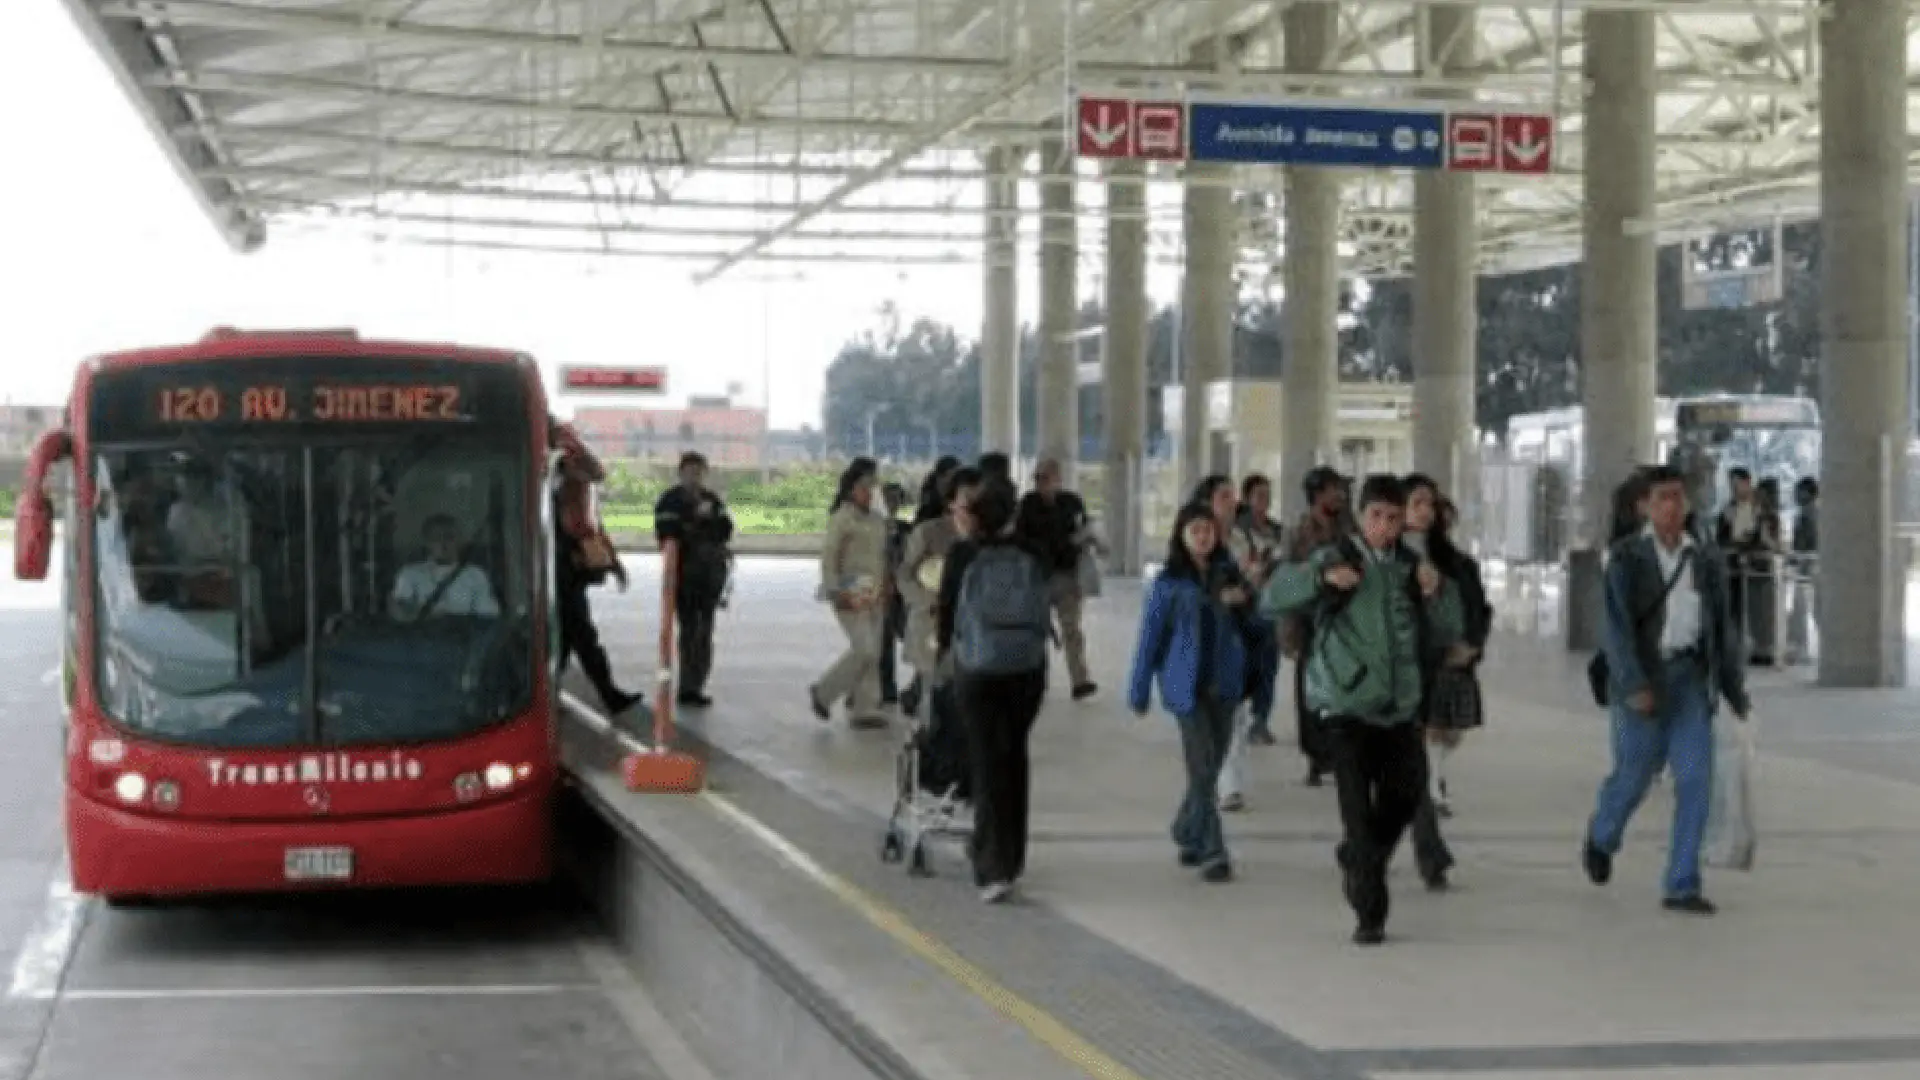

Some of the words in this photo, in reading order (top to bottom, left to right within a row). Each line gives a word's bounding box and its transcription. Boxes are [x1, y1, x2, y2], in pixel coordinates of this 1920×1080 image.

[159, 386, 219, 422] 120
[240, 386, 298, 421] AV.
[313, 384, 461, 421] JIMENEZ
[207, 752, 422, 787] TransMilenio
